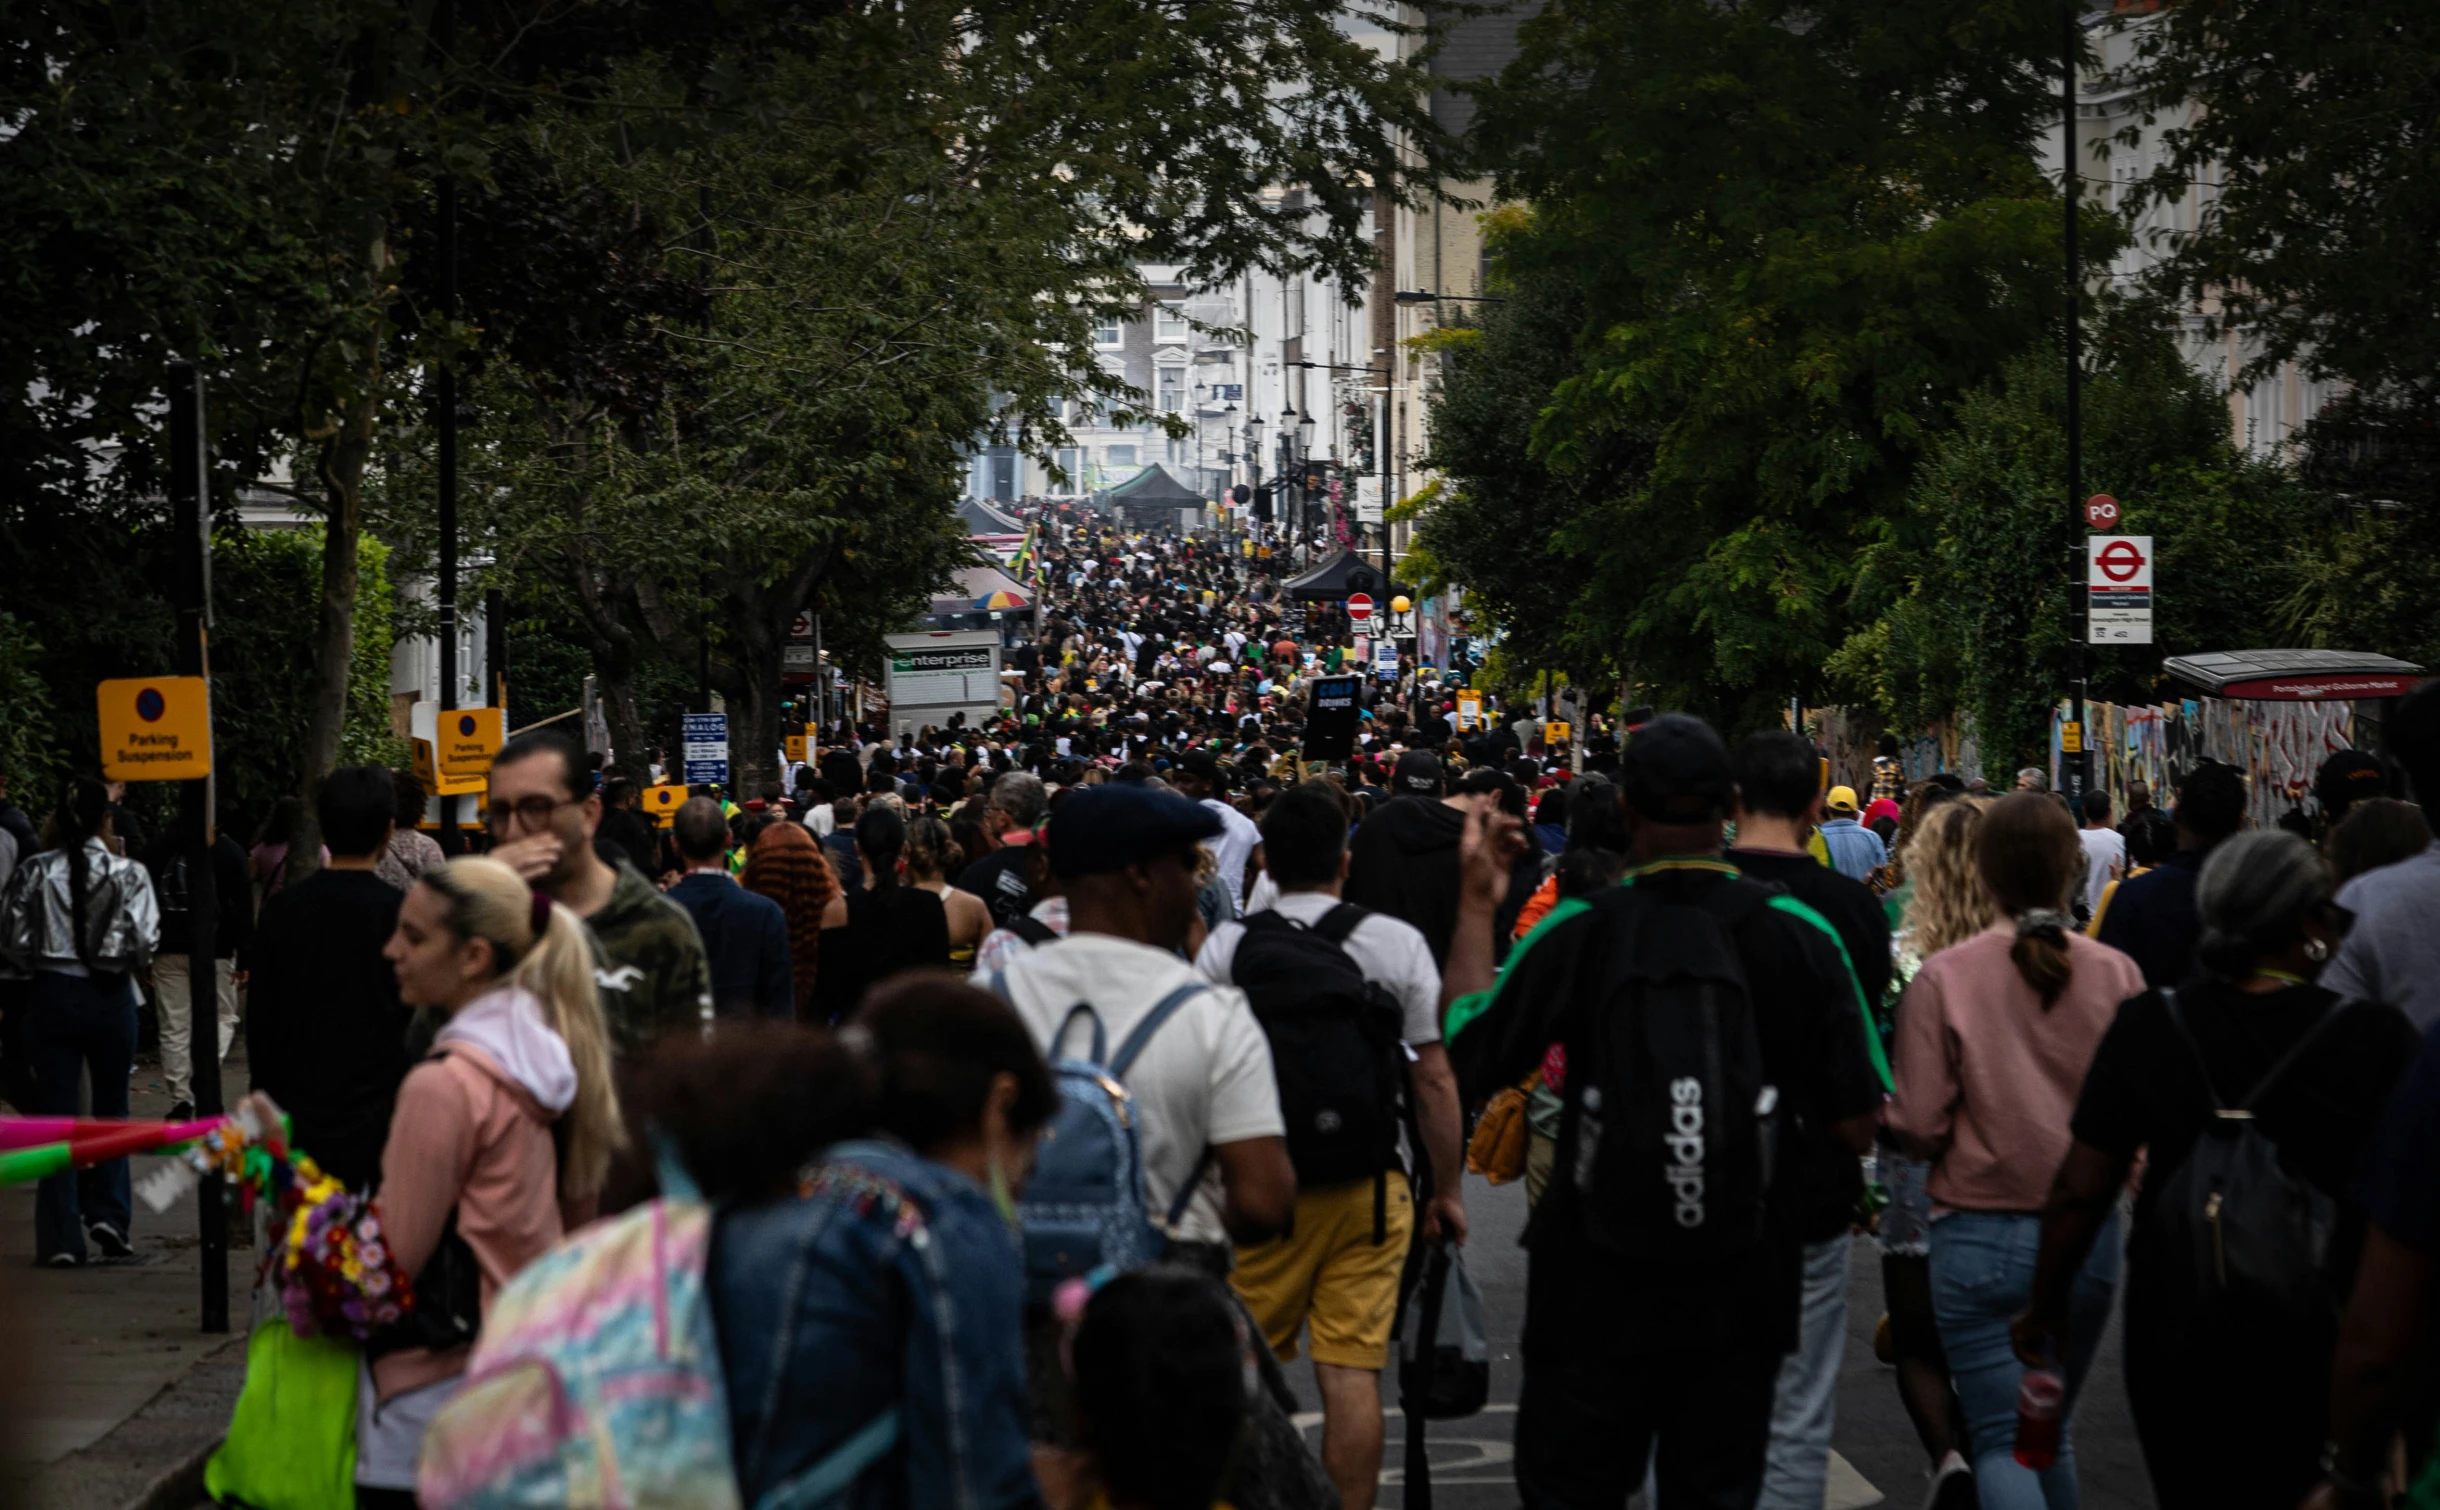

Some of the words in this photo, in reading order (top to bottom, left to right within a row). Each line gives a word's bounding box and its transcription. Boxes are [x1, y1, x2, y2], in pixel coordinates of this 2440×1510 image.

[2089, 503, 2117, 520] PQ
[893, 652, 990, 668] enterprise
[128, 733, 178, 748] Parking
[454, 744, 484, 752] Parking
[117, 750, 194, 763] Suspension
[1662, 1076, 1706, 1230] adidas
